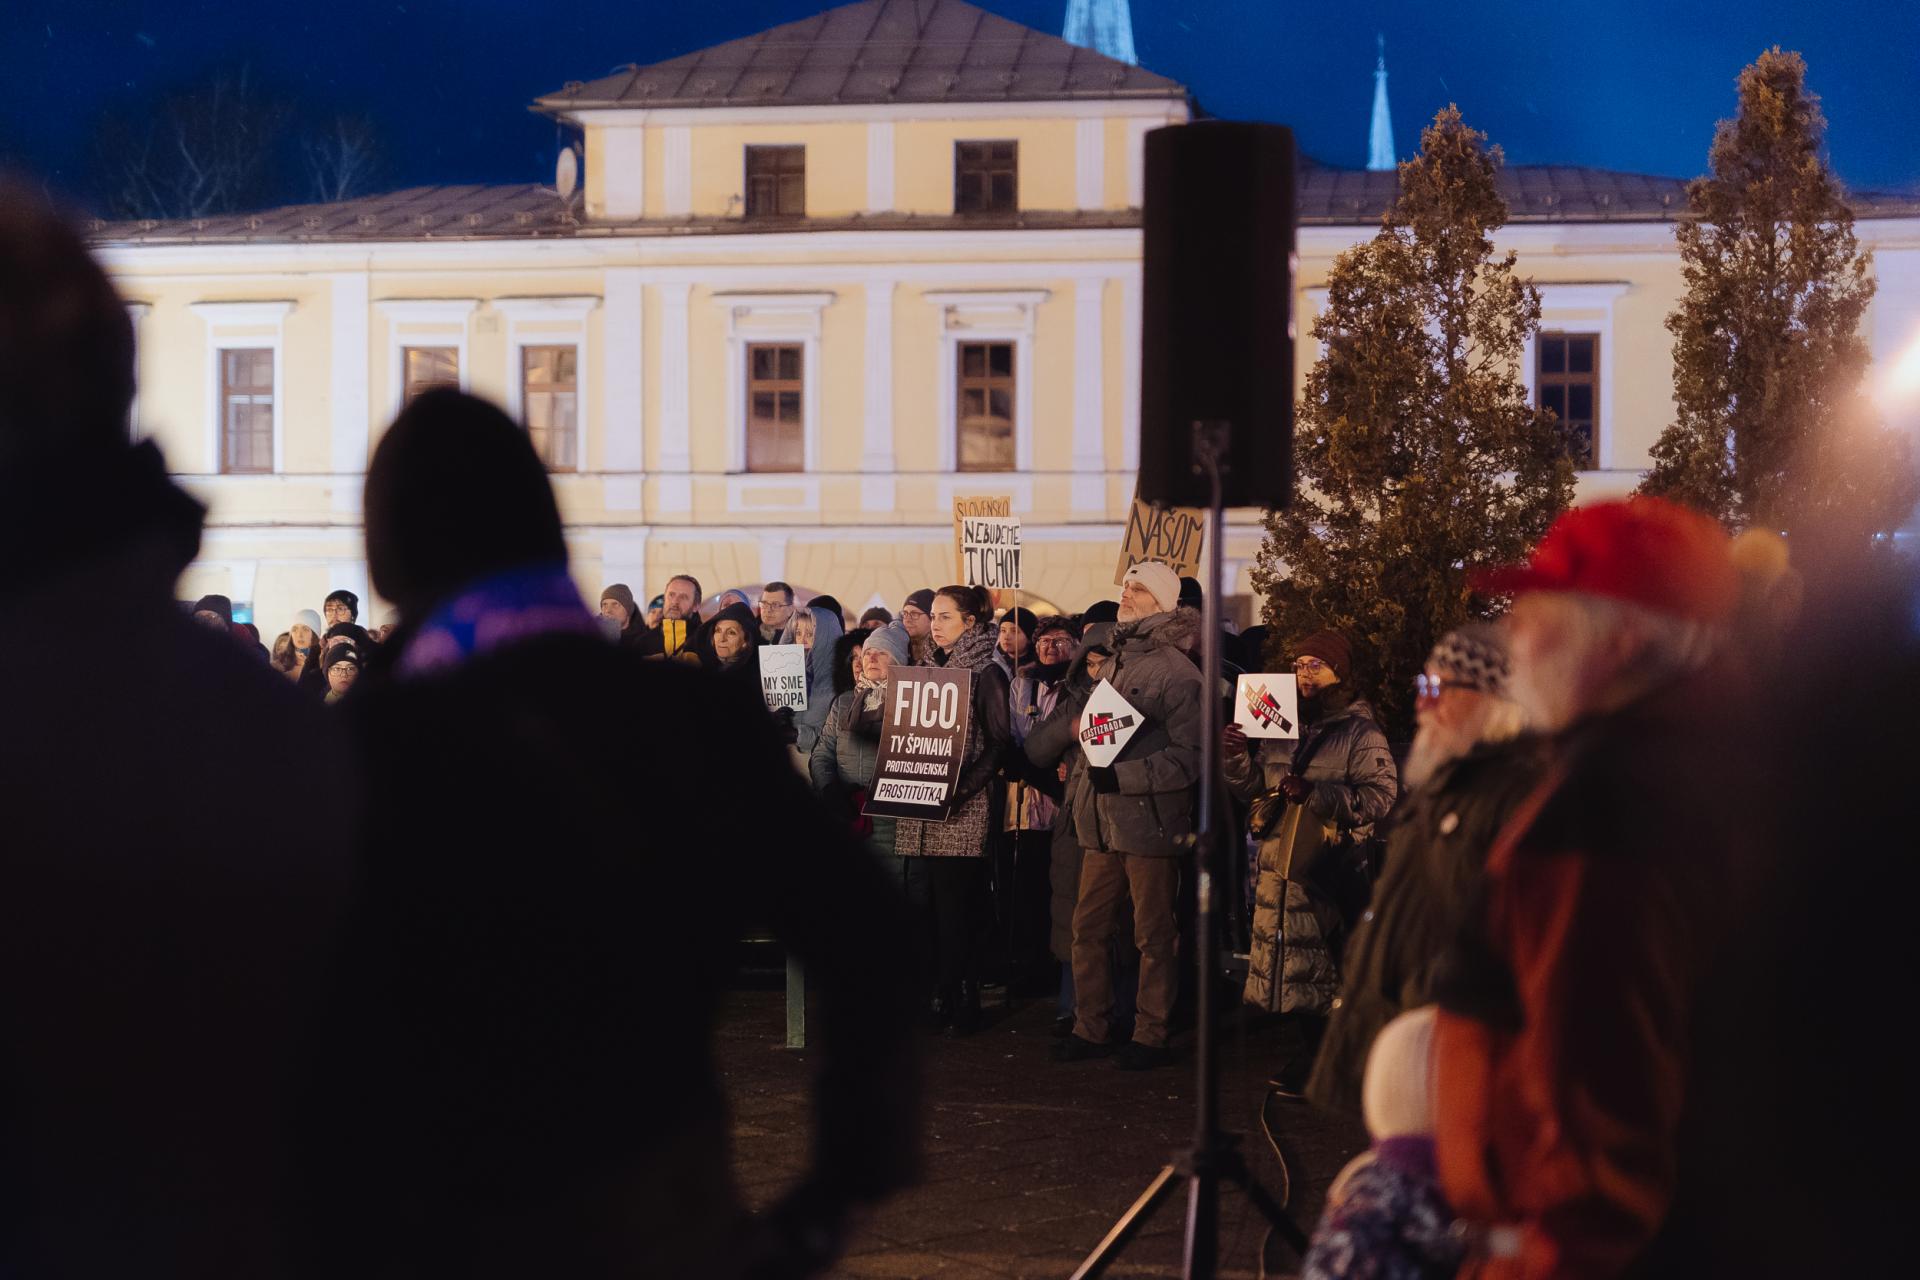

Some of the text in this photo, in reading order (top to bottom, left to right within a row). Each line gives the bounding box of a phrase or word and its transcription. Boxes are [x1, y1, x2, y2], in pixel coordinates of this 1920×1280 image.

[965, 520, 1020, 545] NEBUDEME
[965, 547, 1020, 588] TICHO!
[764, 675, 804, 690] MY SME
[766, 690, 804, 707] EURÓPA
[894, 680, 961, 733] FICO,
[890, 732, 952, 757] TY ŠPINAVÁ
[885, 760, 949, 777] PROTISLOVENSKÁ
[879, 783, 943, 801] PROSTITÚTKA
